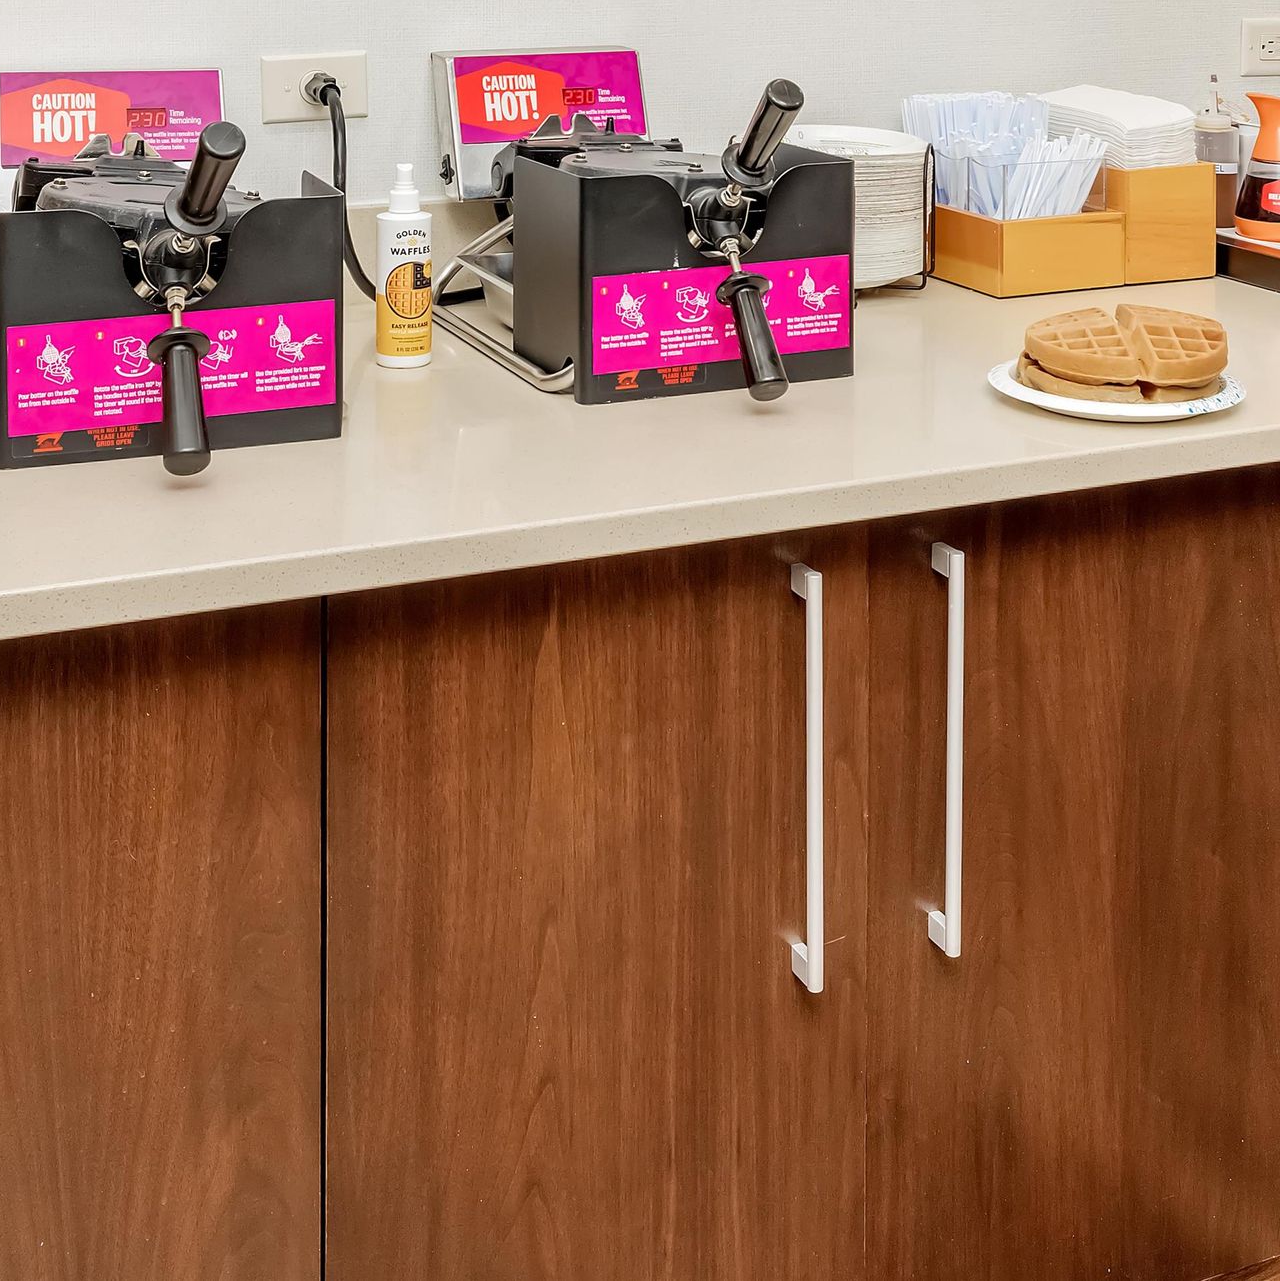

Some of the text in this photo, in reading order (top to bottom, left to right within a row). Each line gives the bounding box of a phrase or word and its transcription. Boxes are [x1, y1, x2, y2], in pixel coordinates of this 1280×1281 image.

[482, 74, 536, 91] CAUTION
[32, 92, 96, 110] CAUTION
[484, 90, 540, 122] HOT!
[169, 109, 184, 117] Time
[33, 110, 97, 143] HOT!
[169, 117, 202, 126] Remaining
[396, 229, 426, 239] GOLDEN
[390, 245, 430, 256] WAFFLES
